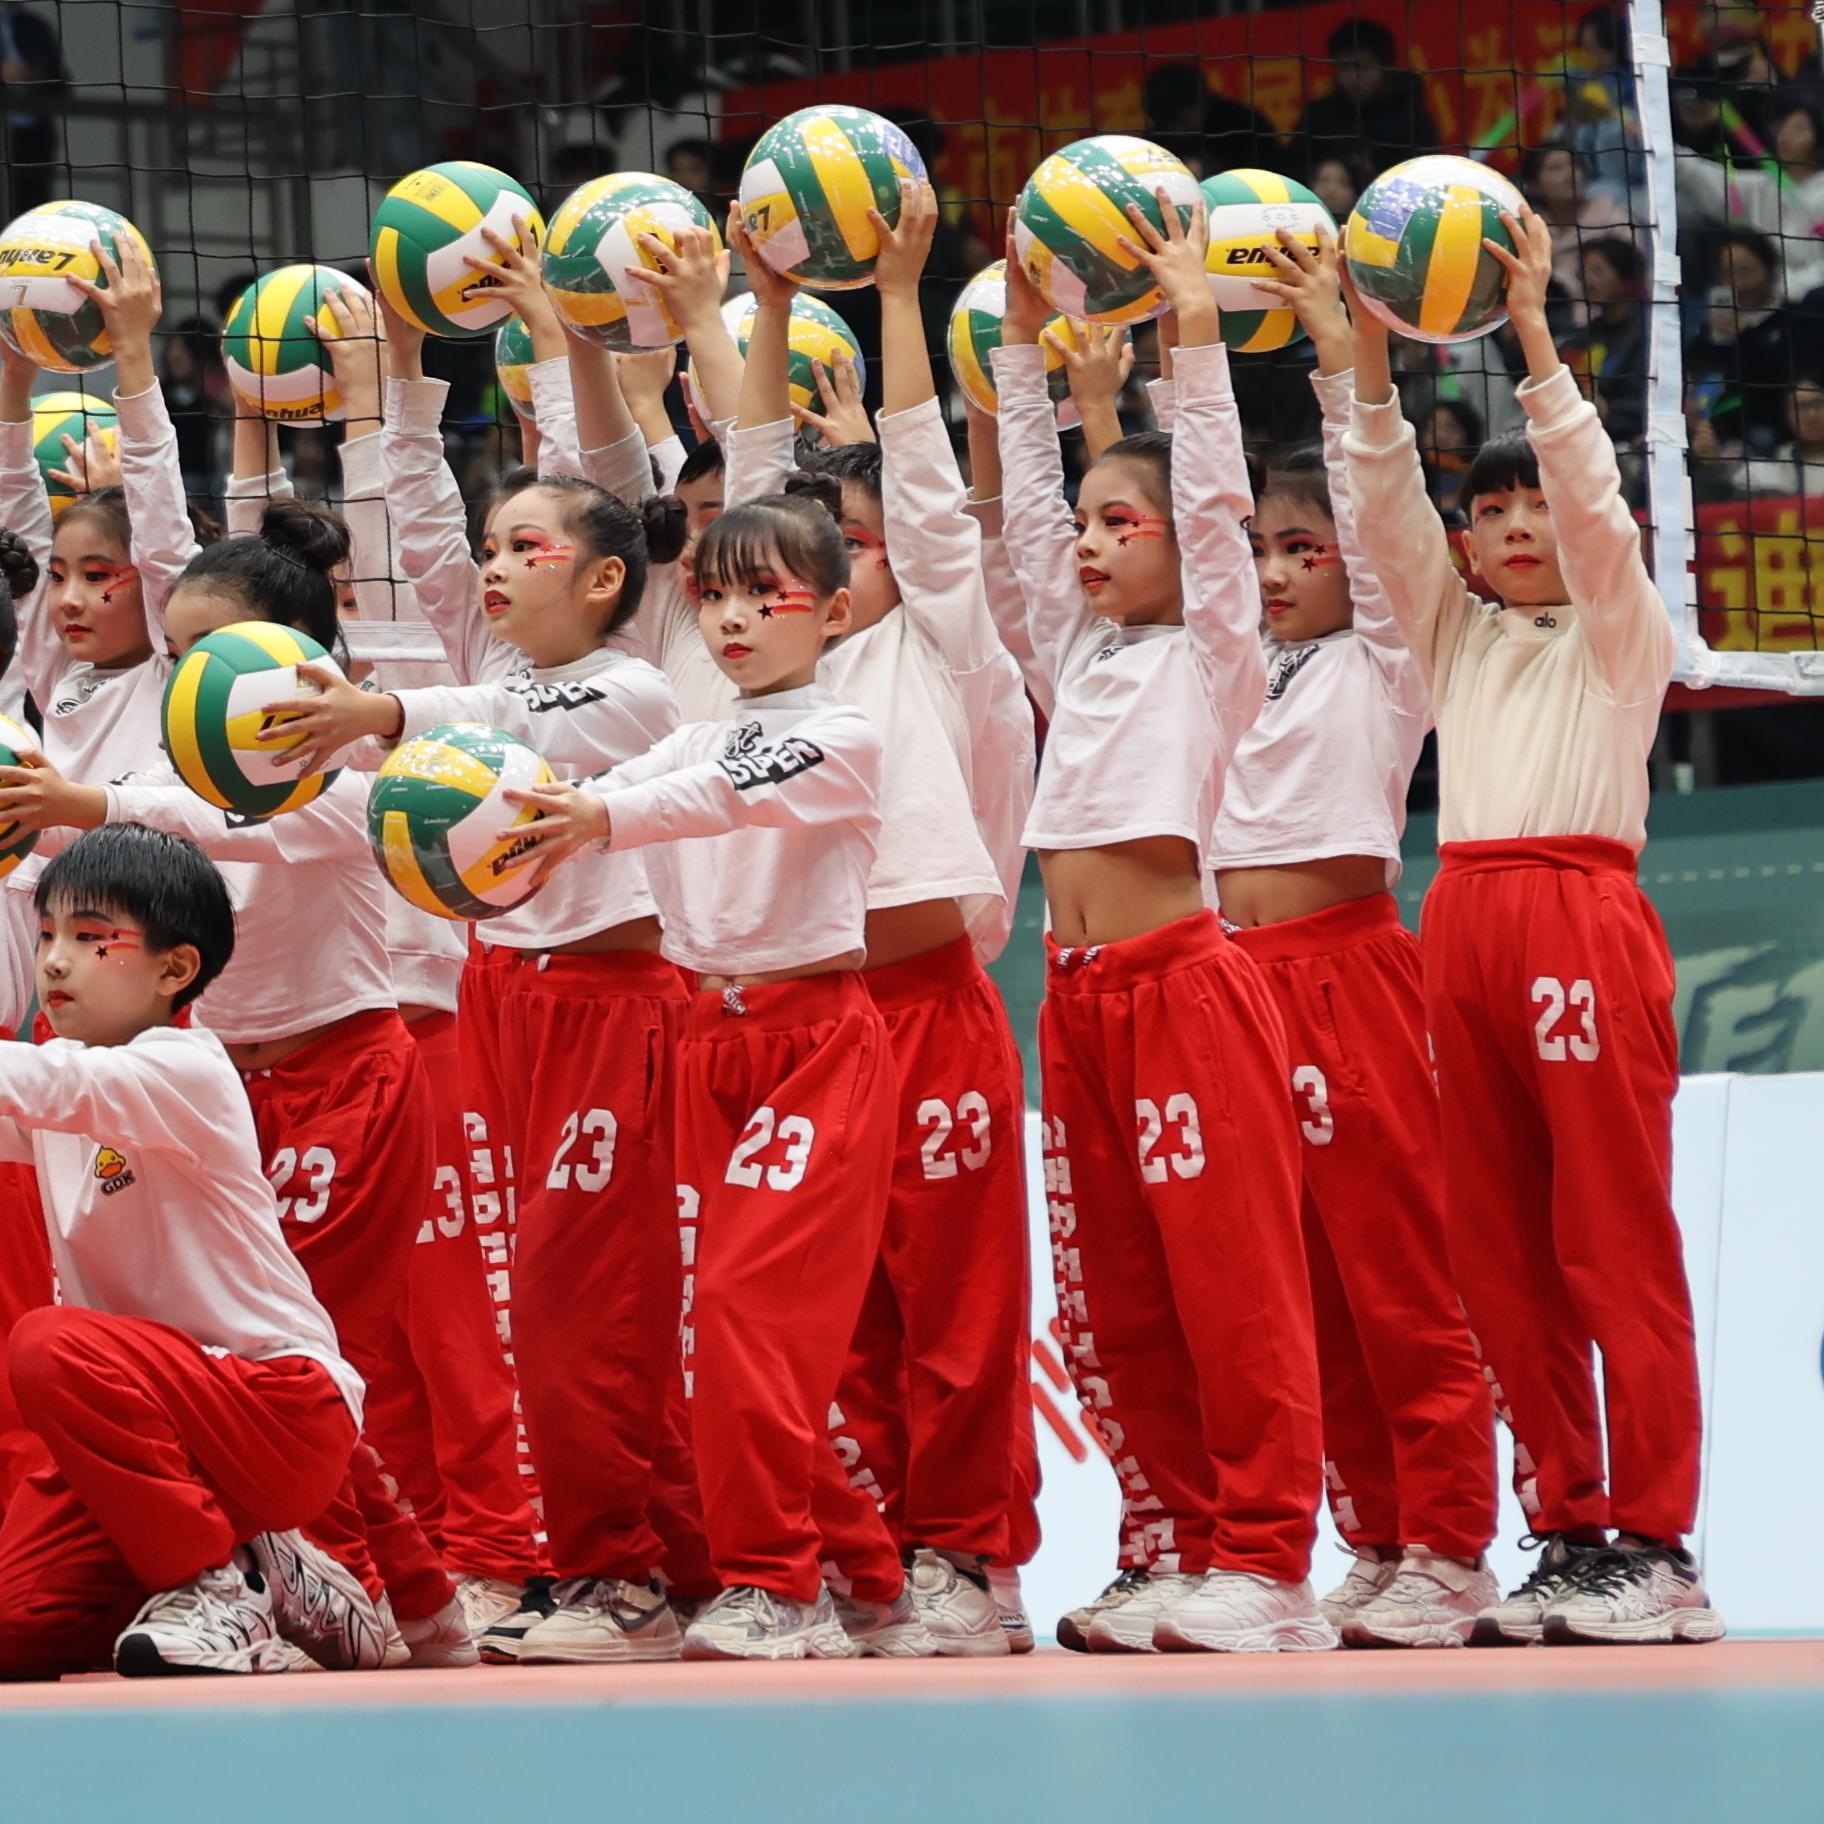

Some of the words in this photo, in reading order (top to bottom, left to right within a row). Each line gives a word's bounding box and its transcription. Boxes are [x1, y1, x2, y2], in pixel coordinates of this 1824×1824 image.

[1534, 616, 1556, 629] alo
[1529, 976, 1601, 1063] 23
[723, 1104, 816, 1193] 23
[915, 1089, 993, 1182] 23
[1135, 1091, 1208, 1185] 23
[1292, 1064, 1335, 1147] 3
[268, 1145, 337, 1225] 23
[544, 1107, 619, 1194] 23
